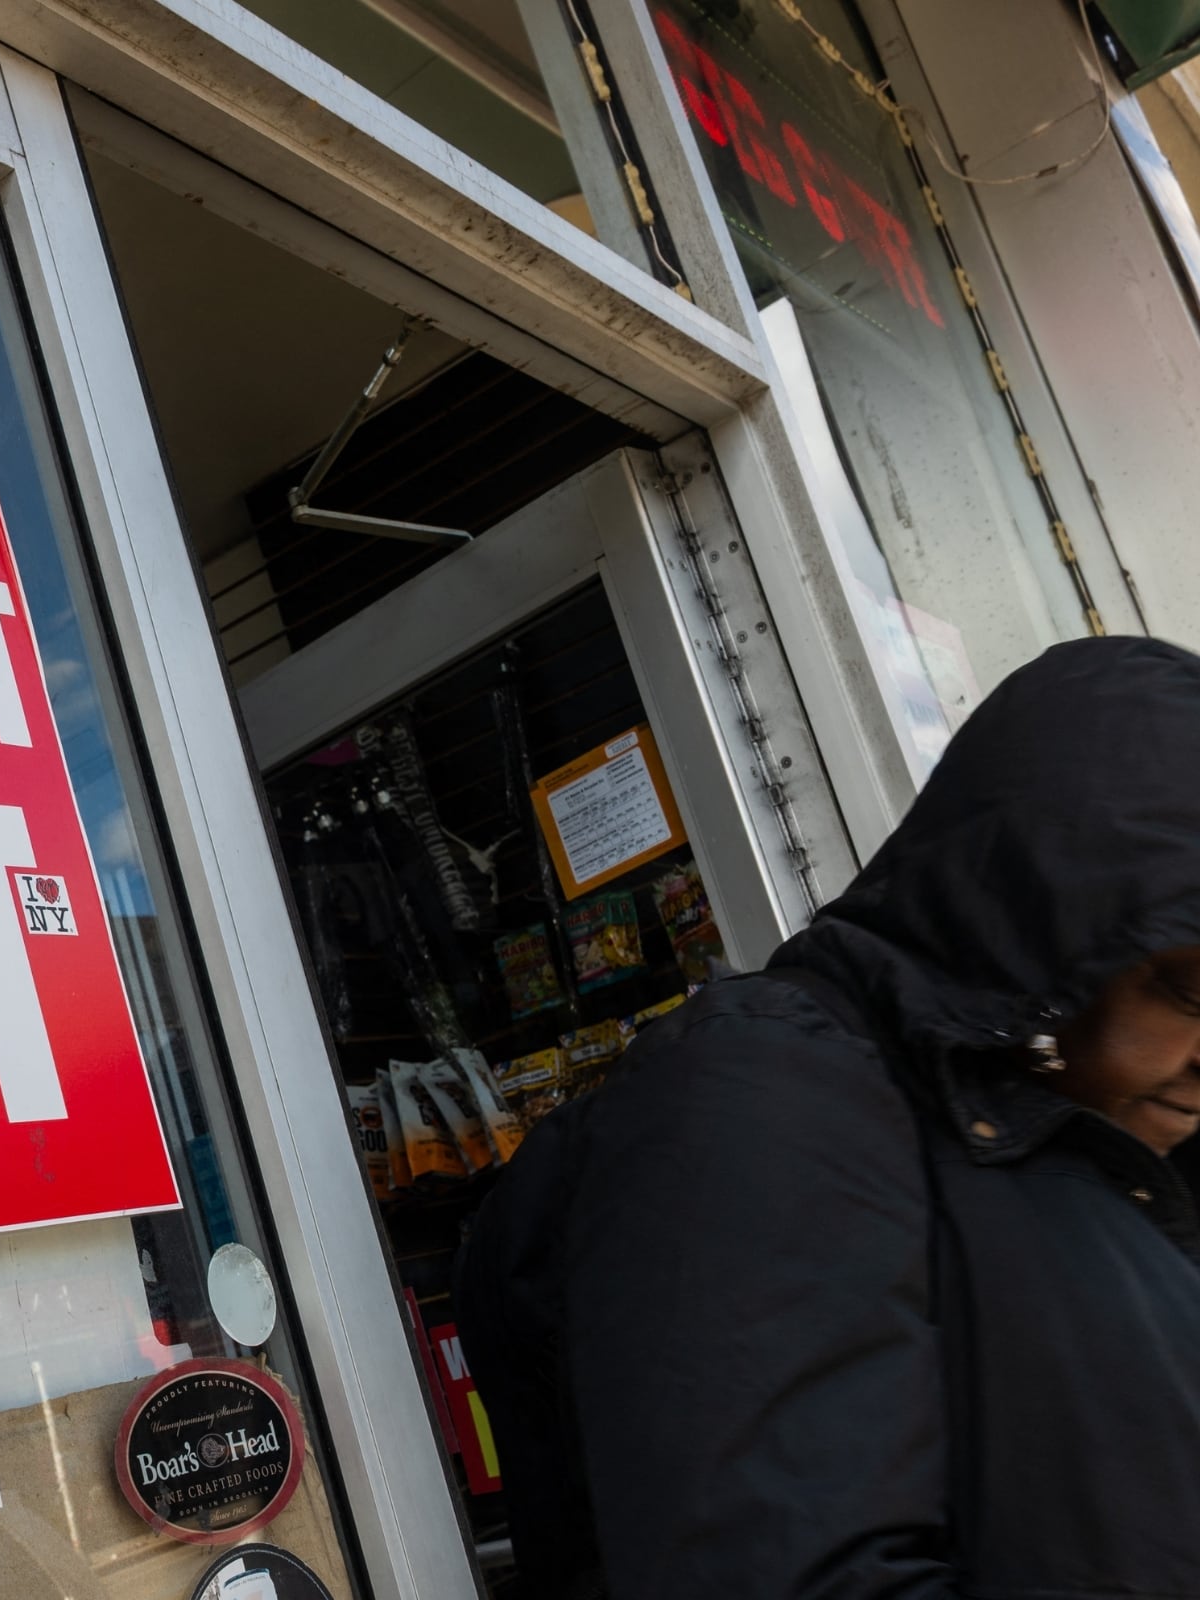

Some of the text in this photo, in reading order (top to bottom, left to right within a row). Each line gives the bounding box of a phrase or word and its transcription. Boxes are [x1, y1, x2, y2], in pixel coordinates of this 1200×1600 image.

[22, 876, 38, 902] I
[25, 905, 69, 932] NY
[145, 1379, 256, 1420] PROUDLY FEATURING
[136, 1419, 281, 1487] Boar's Head
[188, 1473, 242, 1499] CRAFTED
[245, 1461, 285, 1483] FOODS
